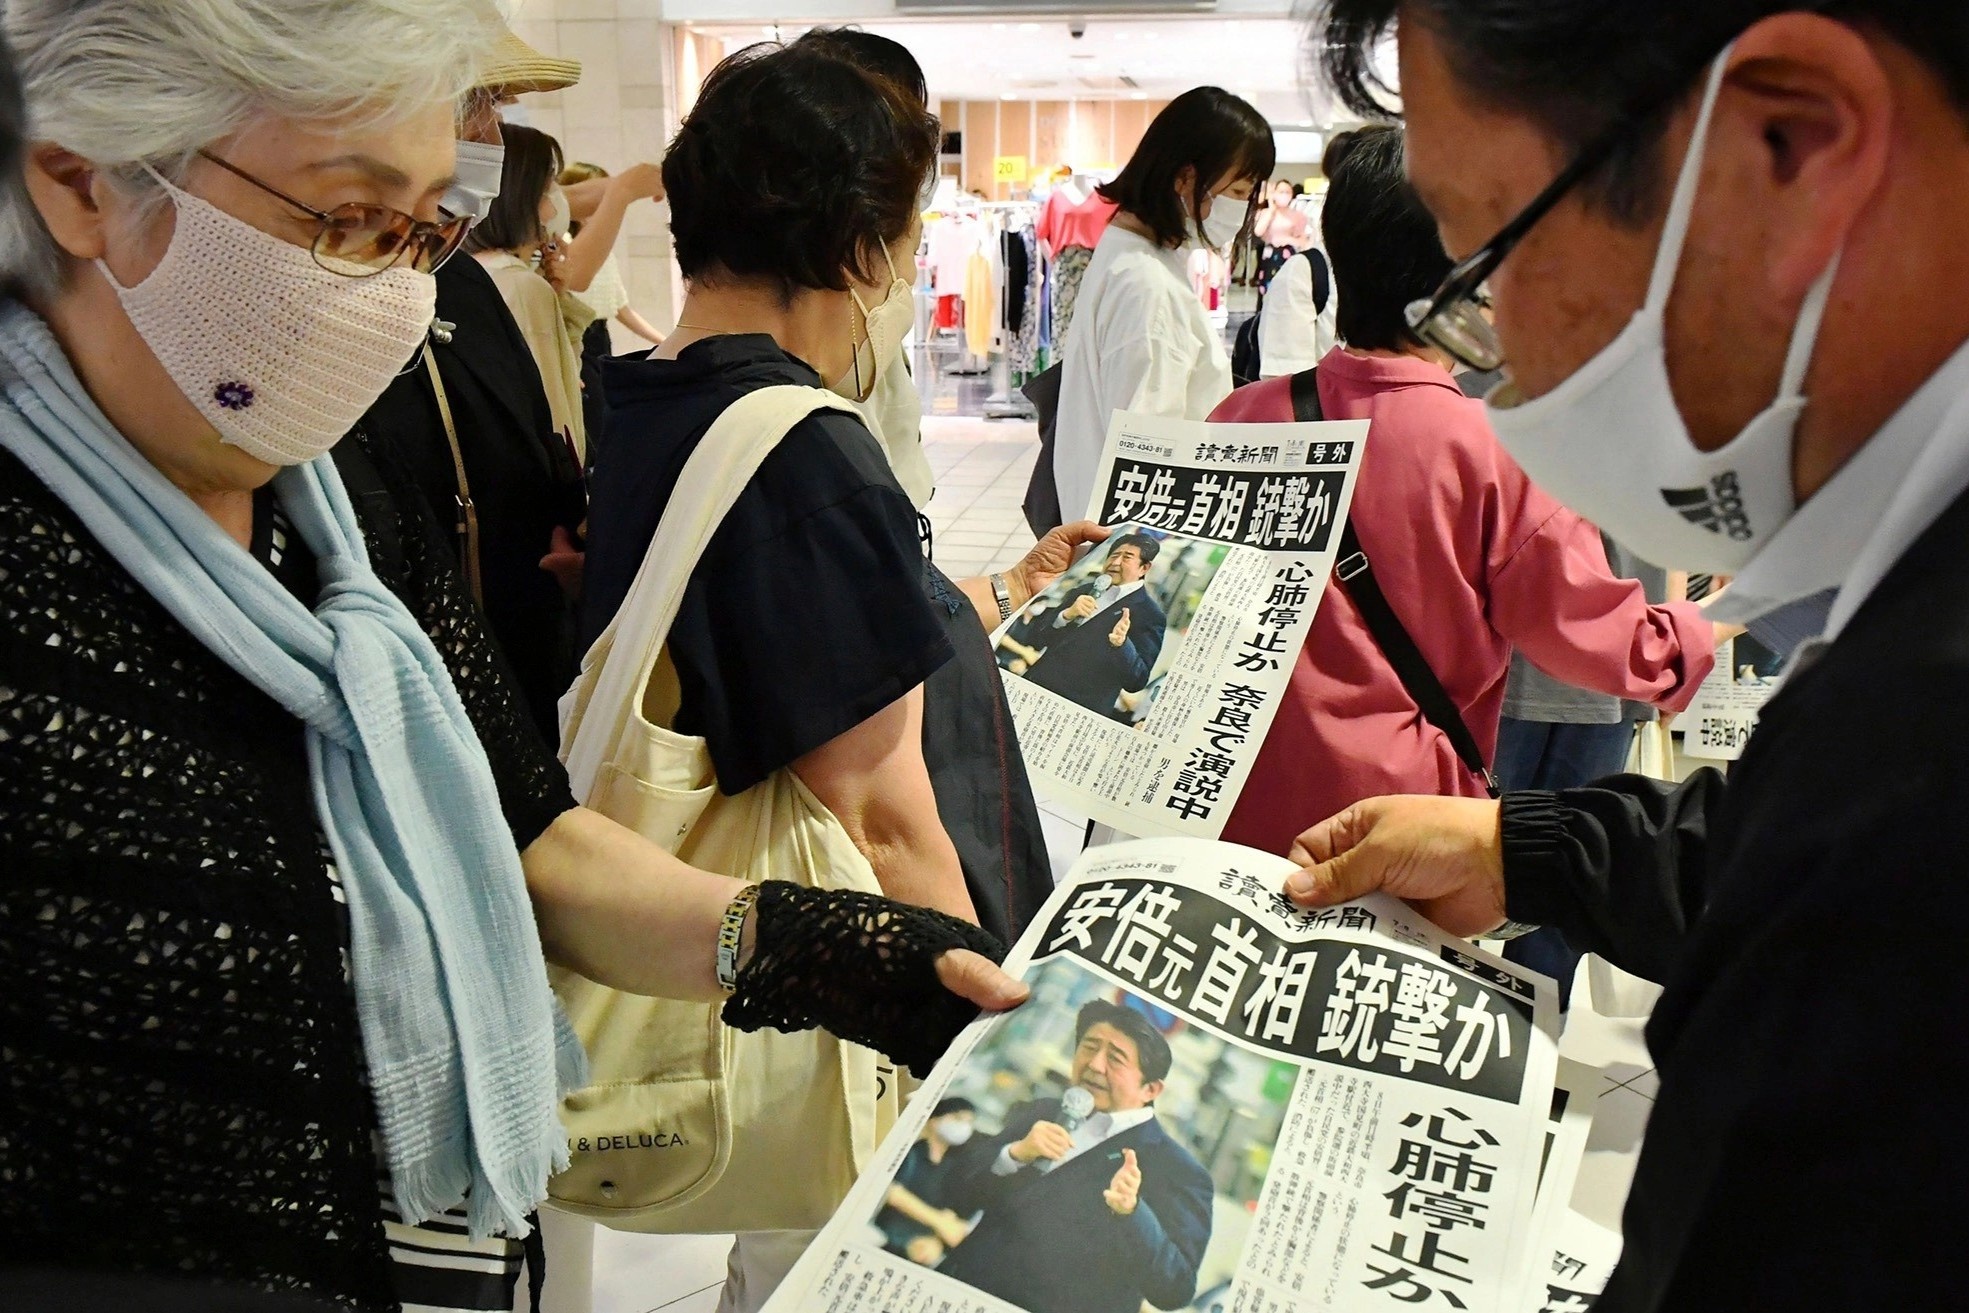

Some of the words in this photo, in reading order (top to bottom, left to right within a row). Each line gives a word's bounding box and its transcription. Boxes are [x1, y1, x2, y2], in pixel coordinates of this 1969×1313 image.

[1312, 443, 1348, 463] 号外
[1107, 464, 1250, 540] 安倍元首相
[1244, 476, 1331, 547] 銃撃か
[1233, 561, 1314, 672] 心肺停止か
[1166, 682, 1268, 820] 奈良で演説中
[1049, 882, 1318, 1045] 安倍元首相
[1316, 948, 1511, 1081] 銃撃か
[1453, 952, 1523, 992] 号外
[577, 1137, 590, 1152] &
[1361, 1106, 1501, 1311] 心肺停止か
